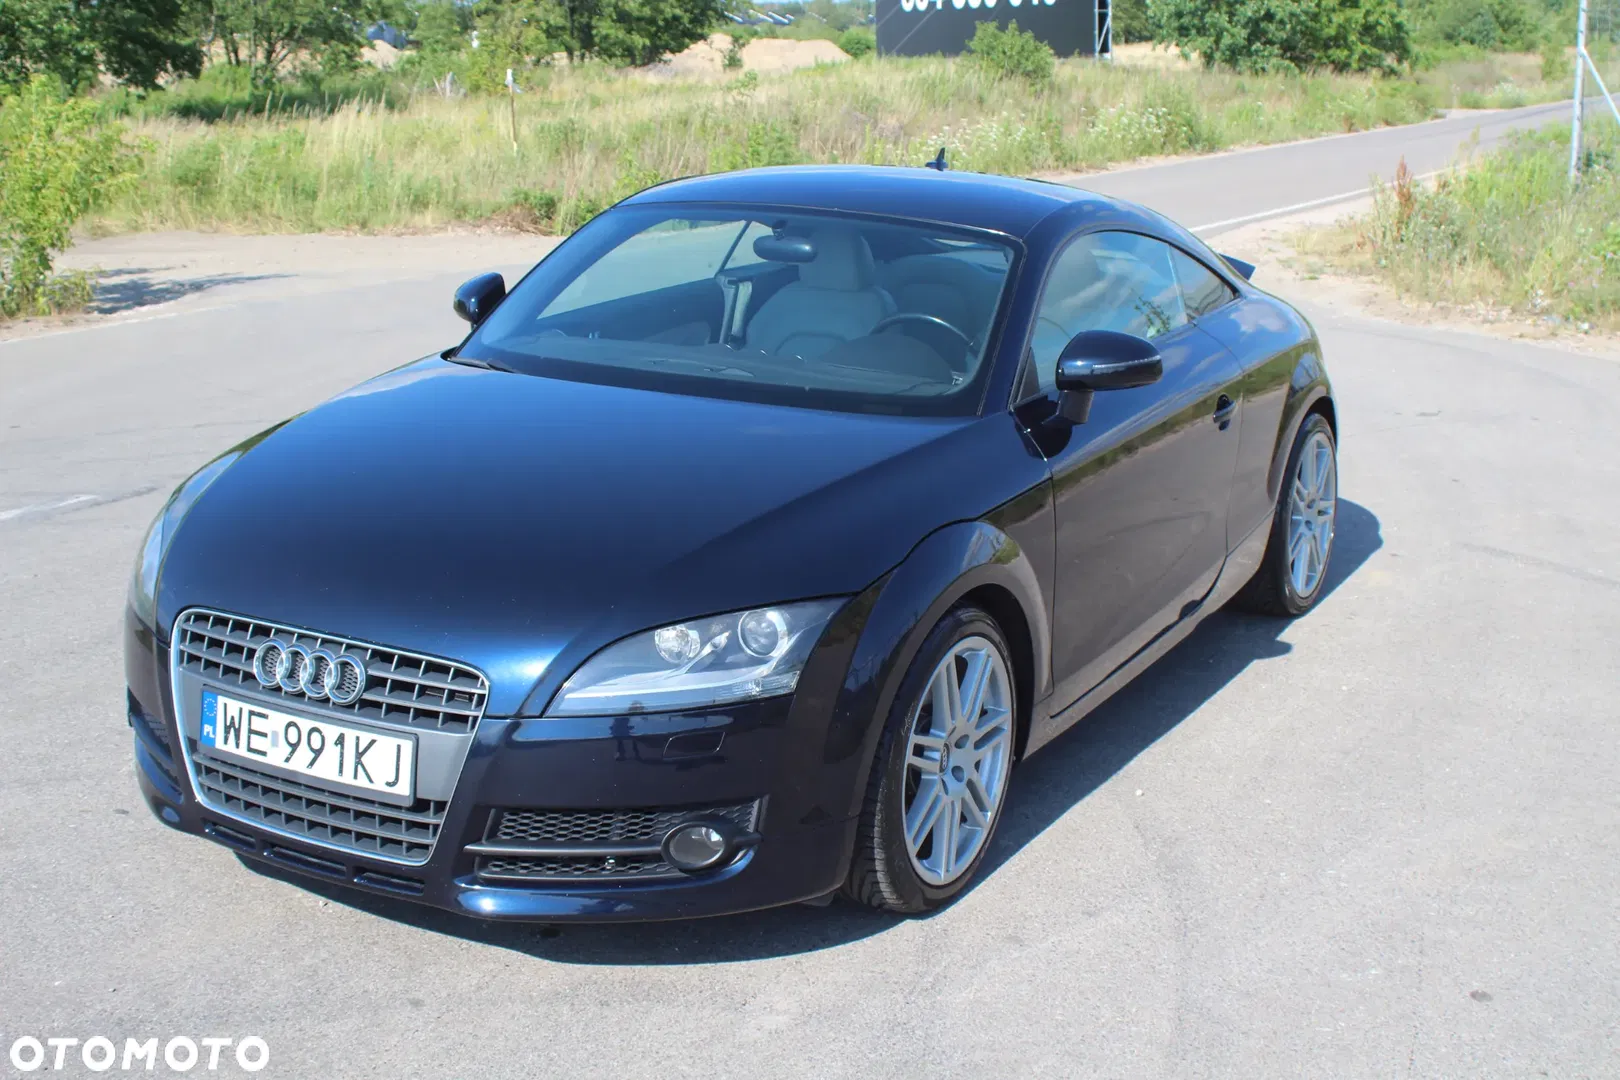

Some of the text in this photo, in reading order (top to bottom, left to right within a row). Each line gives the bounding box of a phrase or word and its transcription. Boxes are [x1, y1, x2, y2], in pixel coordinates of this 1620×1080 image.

[203, 723, 215, 739] PL
[223, 702, 402, 788] WE 991KJ
